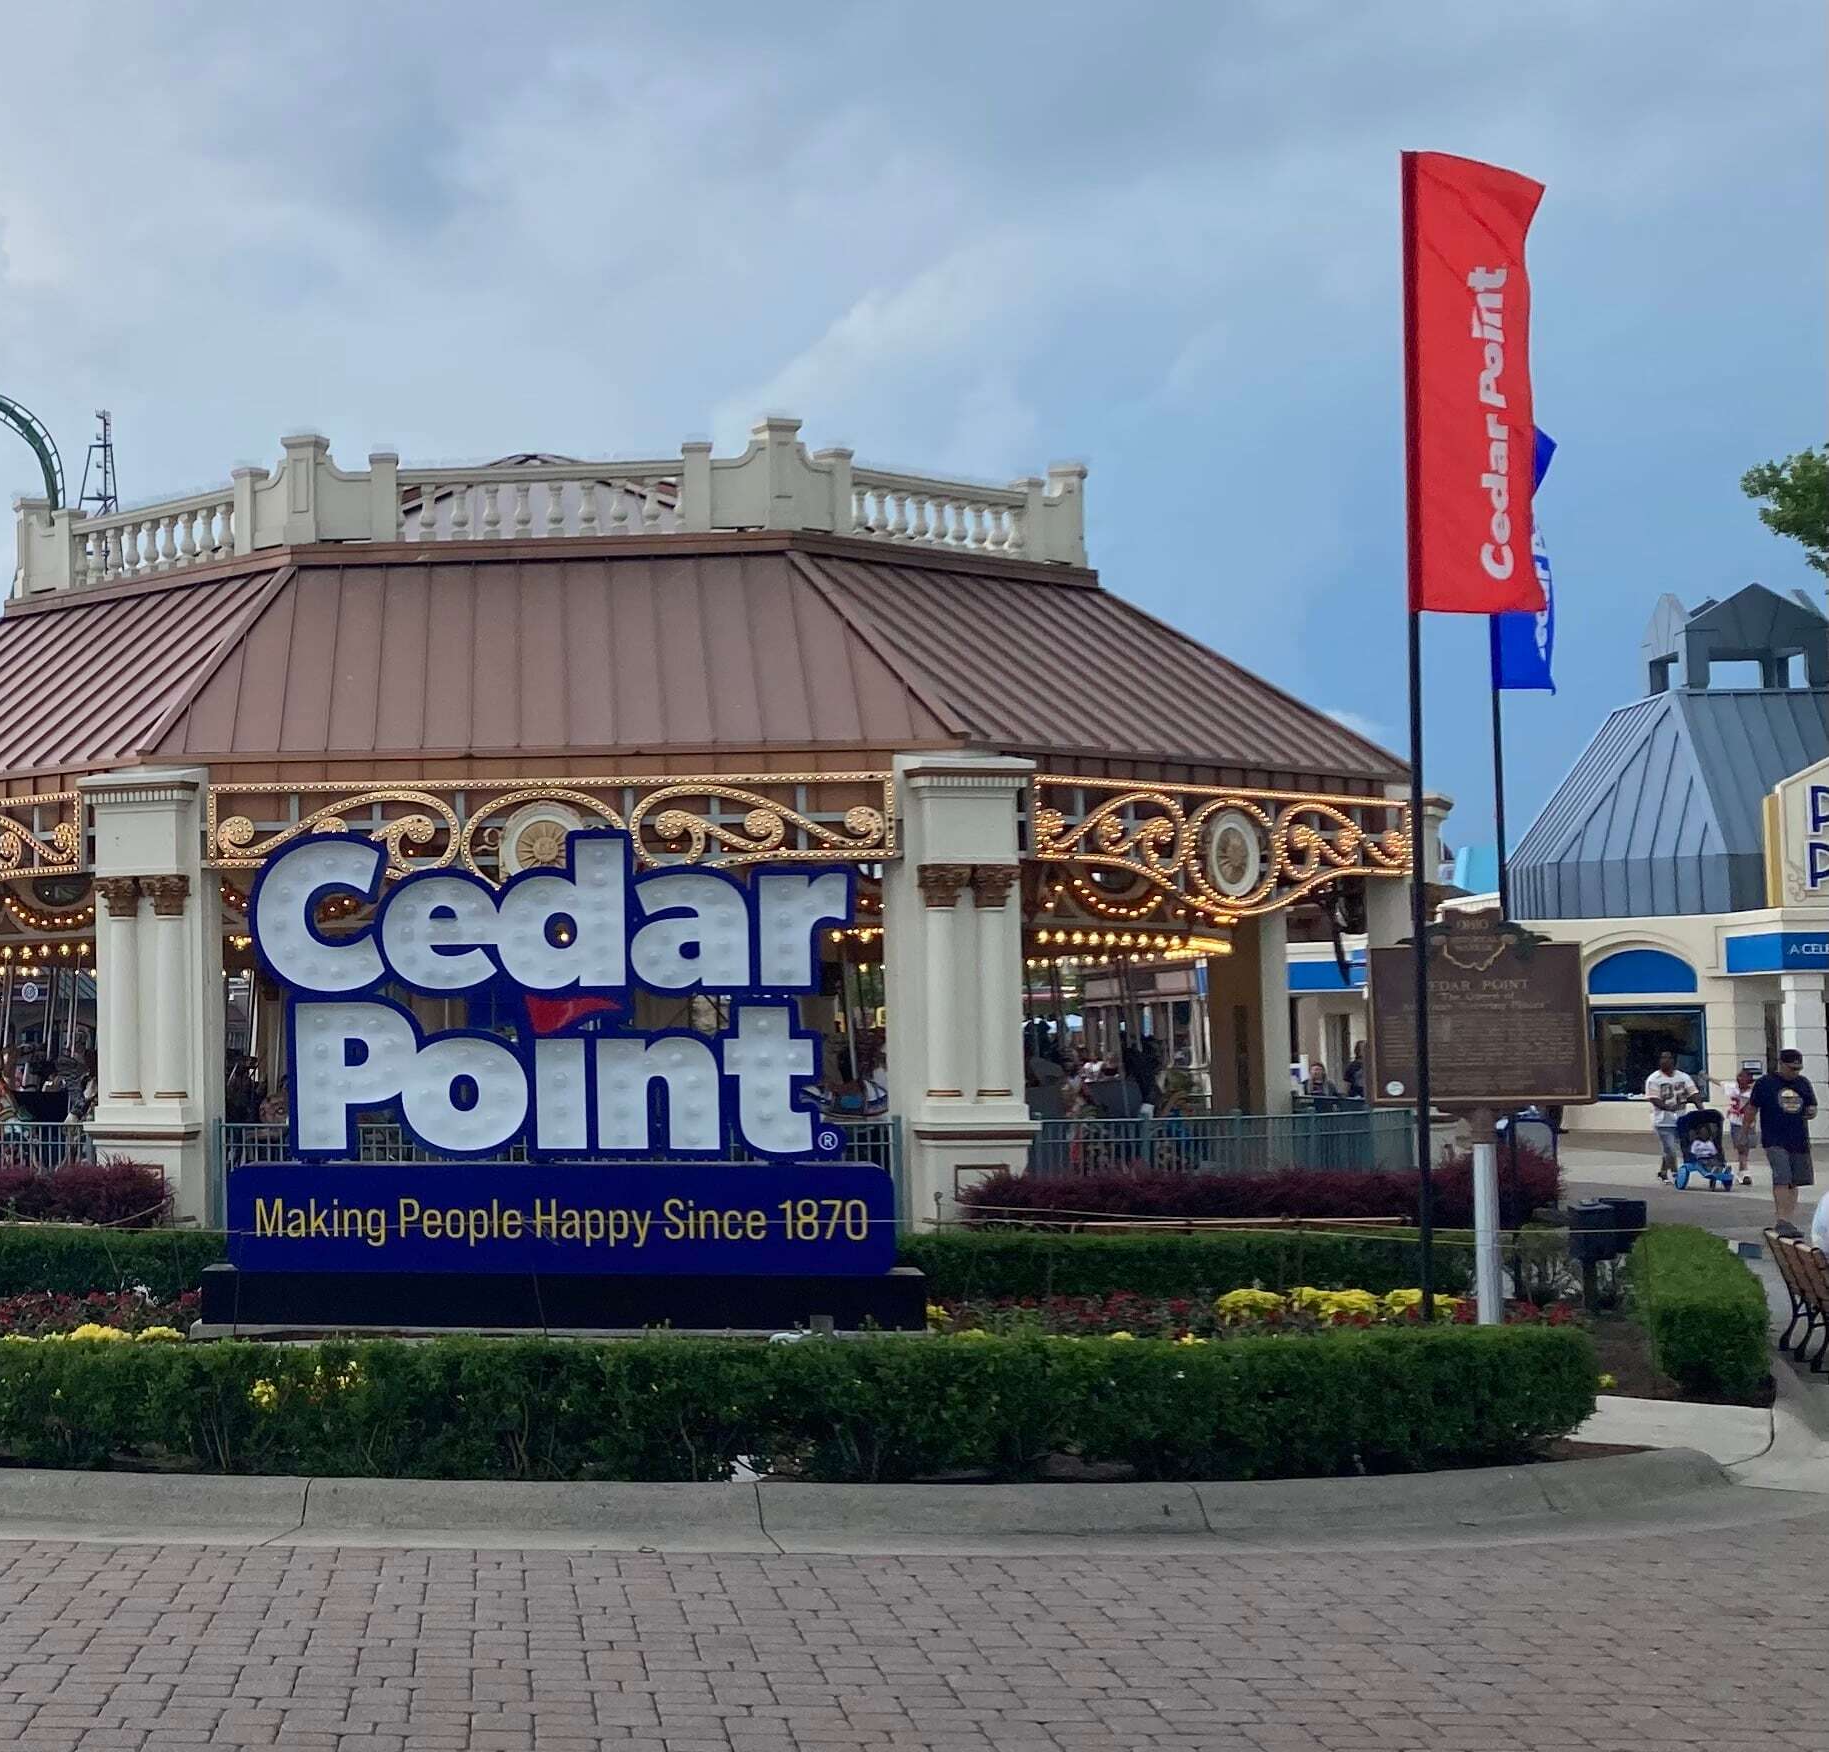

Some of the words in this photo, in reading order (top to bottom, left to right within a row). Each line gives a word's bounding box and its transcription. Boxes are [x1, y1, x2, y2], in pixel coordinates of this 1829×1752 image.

[1467, 265, 1509, 409] Point
[1480, 412, 1514, 580] Cedar
[255, 838, 849, 992] Cedar
[295, 997, 815, 1153] Point
[255, 1197, 386, 1247] Making
[398, 1197, 522, 1247] People
[534, 1198, 651, 1248] Happy
[663, 1198, 768, 1240] Since
[778, 1199, 868, 1240] 1870
